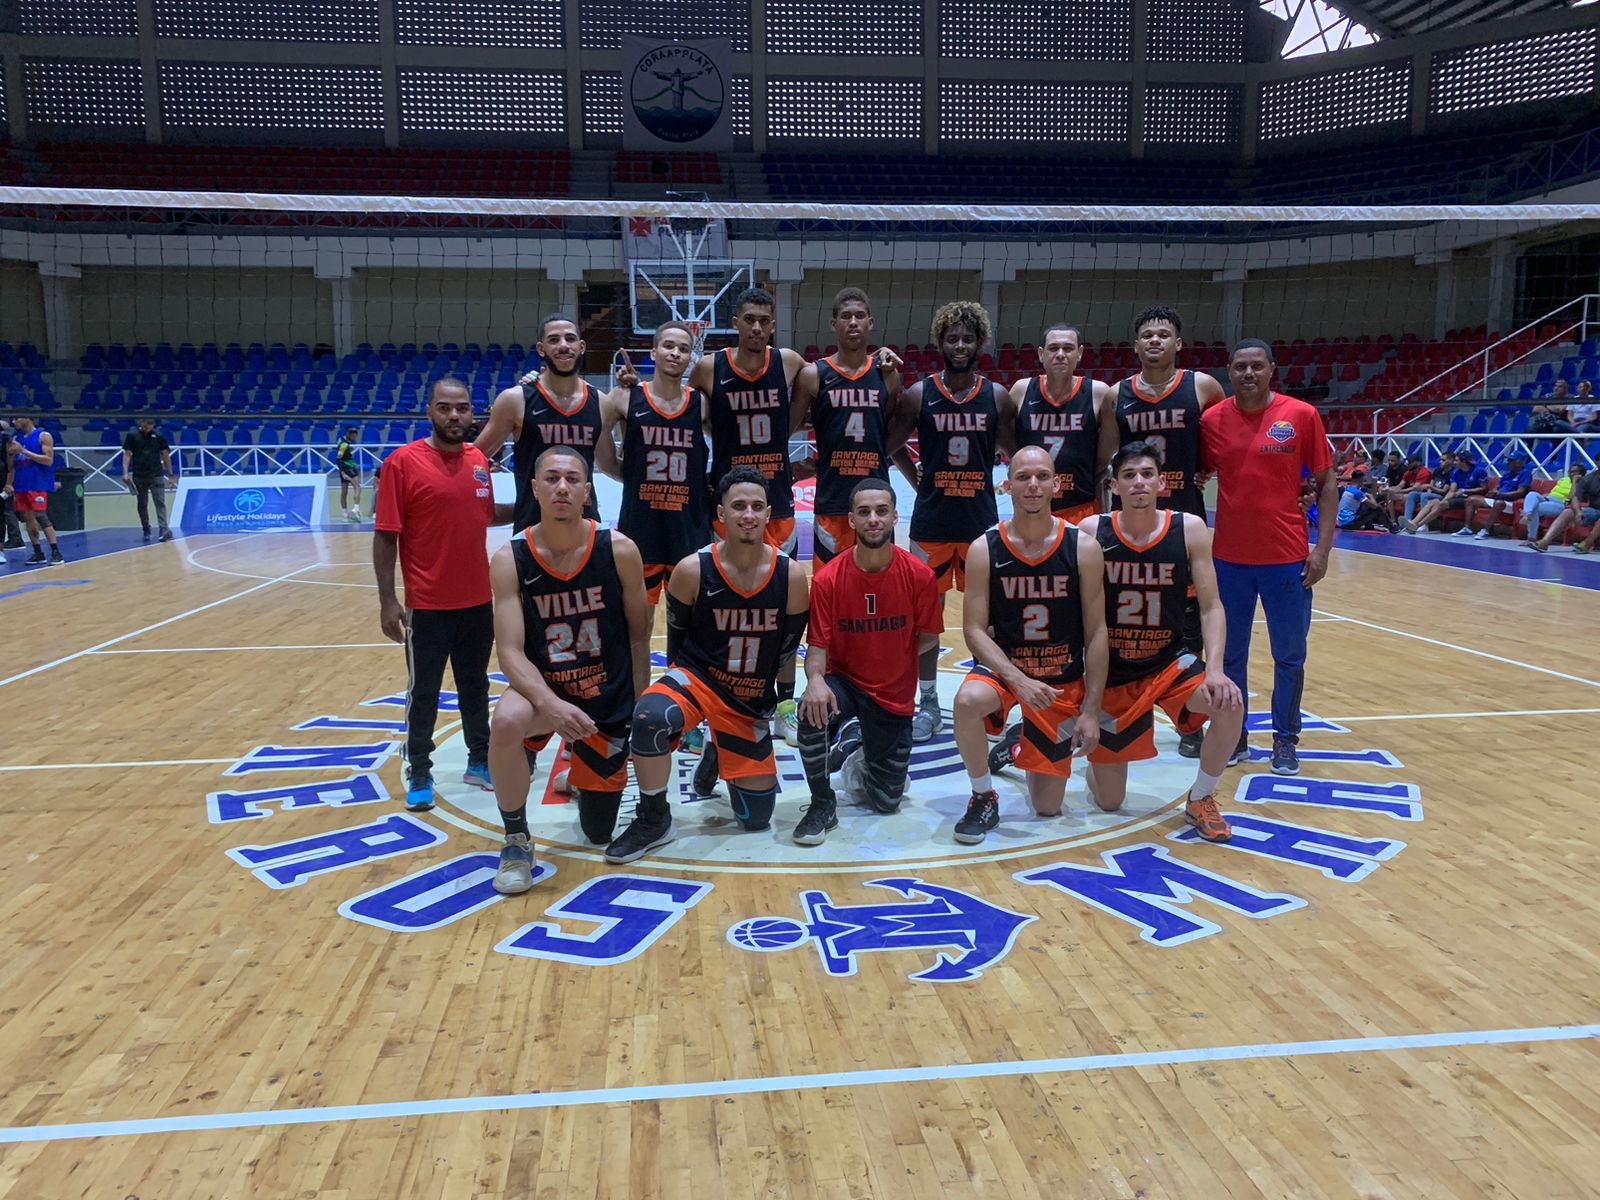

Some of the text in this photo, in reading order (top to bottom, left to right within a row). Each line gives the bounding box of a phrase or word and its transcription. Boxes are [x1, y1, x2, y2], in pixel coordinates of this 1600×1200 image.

[640, 48, 714, 75] CORAAPPLATA
[726, 388, 781, 411] VILLE
[827, 388, 881, 408] VILLE
[736, 413, 772, 446] 10
[844, 411, 866, 443] 4
[932, 412, 988, 432] VILLE
[1029, 412, 1085, 432] VILLE
[1125, 408, 1187, 433] VILLE
[537, 422, 595, 447] VILLE
[640, 424, 694, 449] VILLE
[731, 453, 783, 465] SANTIAGO
[831, 450, 880, 461] SANTIAGO
[948, 435, 970, 467] 9
[1042, 435, 1066, 461] 7
[645, 450, 688, 482] 20
[934, 471, 986, 481] SANTIAGO
[640, 484, 690, 495] SANTIAGO
[206, 512, 287, 523] Lifestyle Holidays
[1103, 560, 1176, 586] VILLE
[1000, 575, 1070, 599] VILLE
[532, 585, 606, 619] VILLE
[864, 593, 876, 615] 1
[1117, 590, 1162, 627] 21
[712, 607, 780, 632] VILLE
[838, 614, 908, 633] SANTIAGO
[1022, 603, 1050, 641] 2
[544, 617, 602, 664] 24
[1107, 628, 1173, 640] SANTIAGO
[727, 635, 761, 674] 11
[543, 662, 604, 683] SANTIAGO
[708, 665, 767, 689] SANTIAGO
